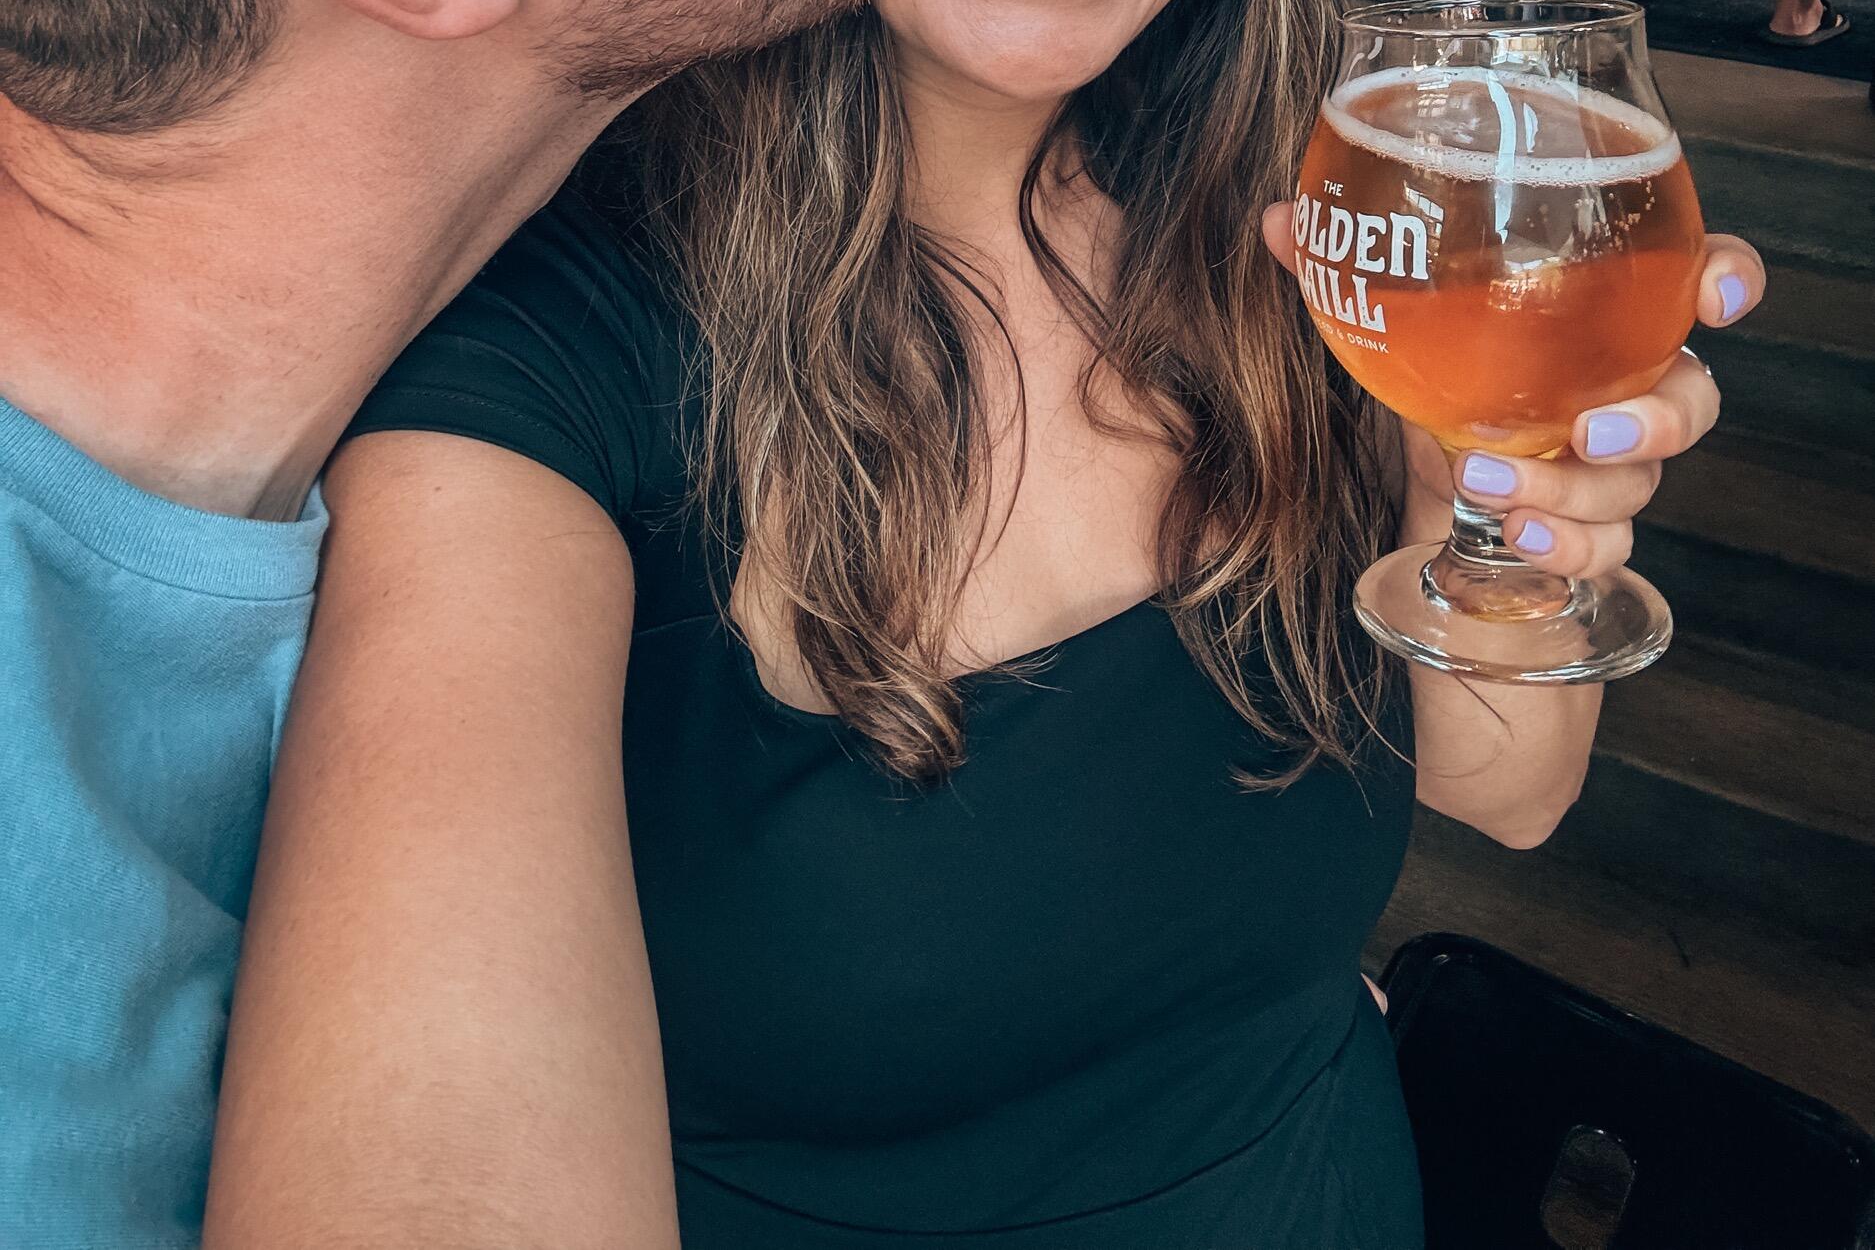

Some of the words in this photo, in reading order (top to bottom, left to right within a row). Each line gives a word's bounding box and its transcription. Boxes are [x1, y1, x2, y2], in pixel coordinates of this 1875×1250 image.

[1324, 180, 1344, 197] THE
[1291, 190, 1429, 280] OLDEN
[1295, 250, 1387, 333] MILL
[1347, 332, 1389, 354] DRINK
